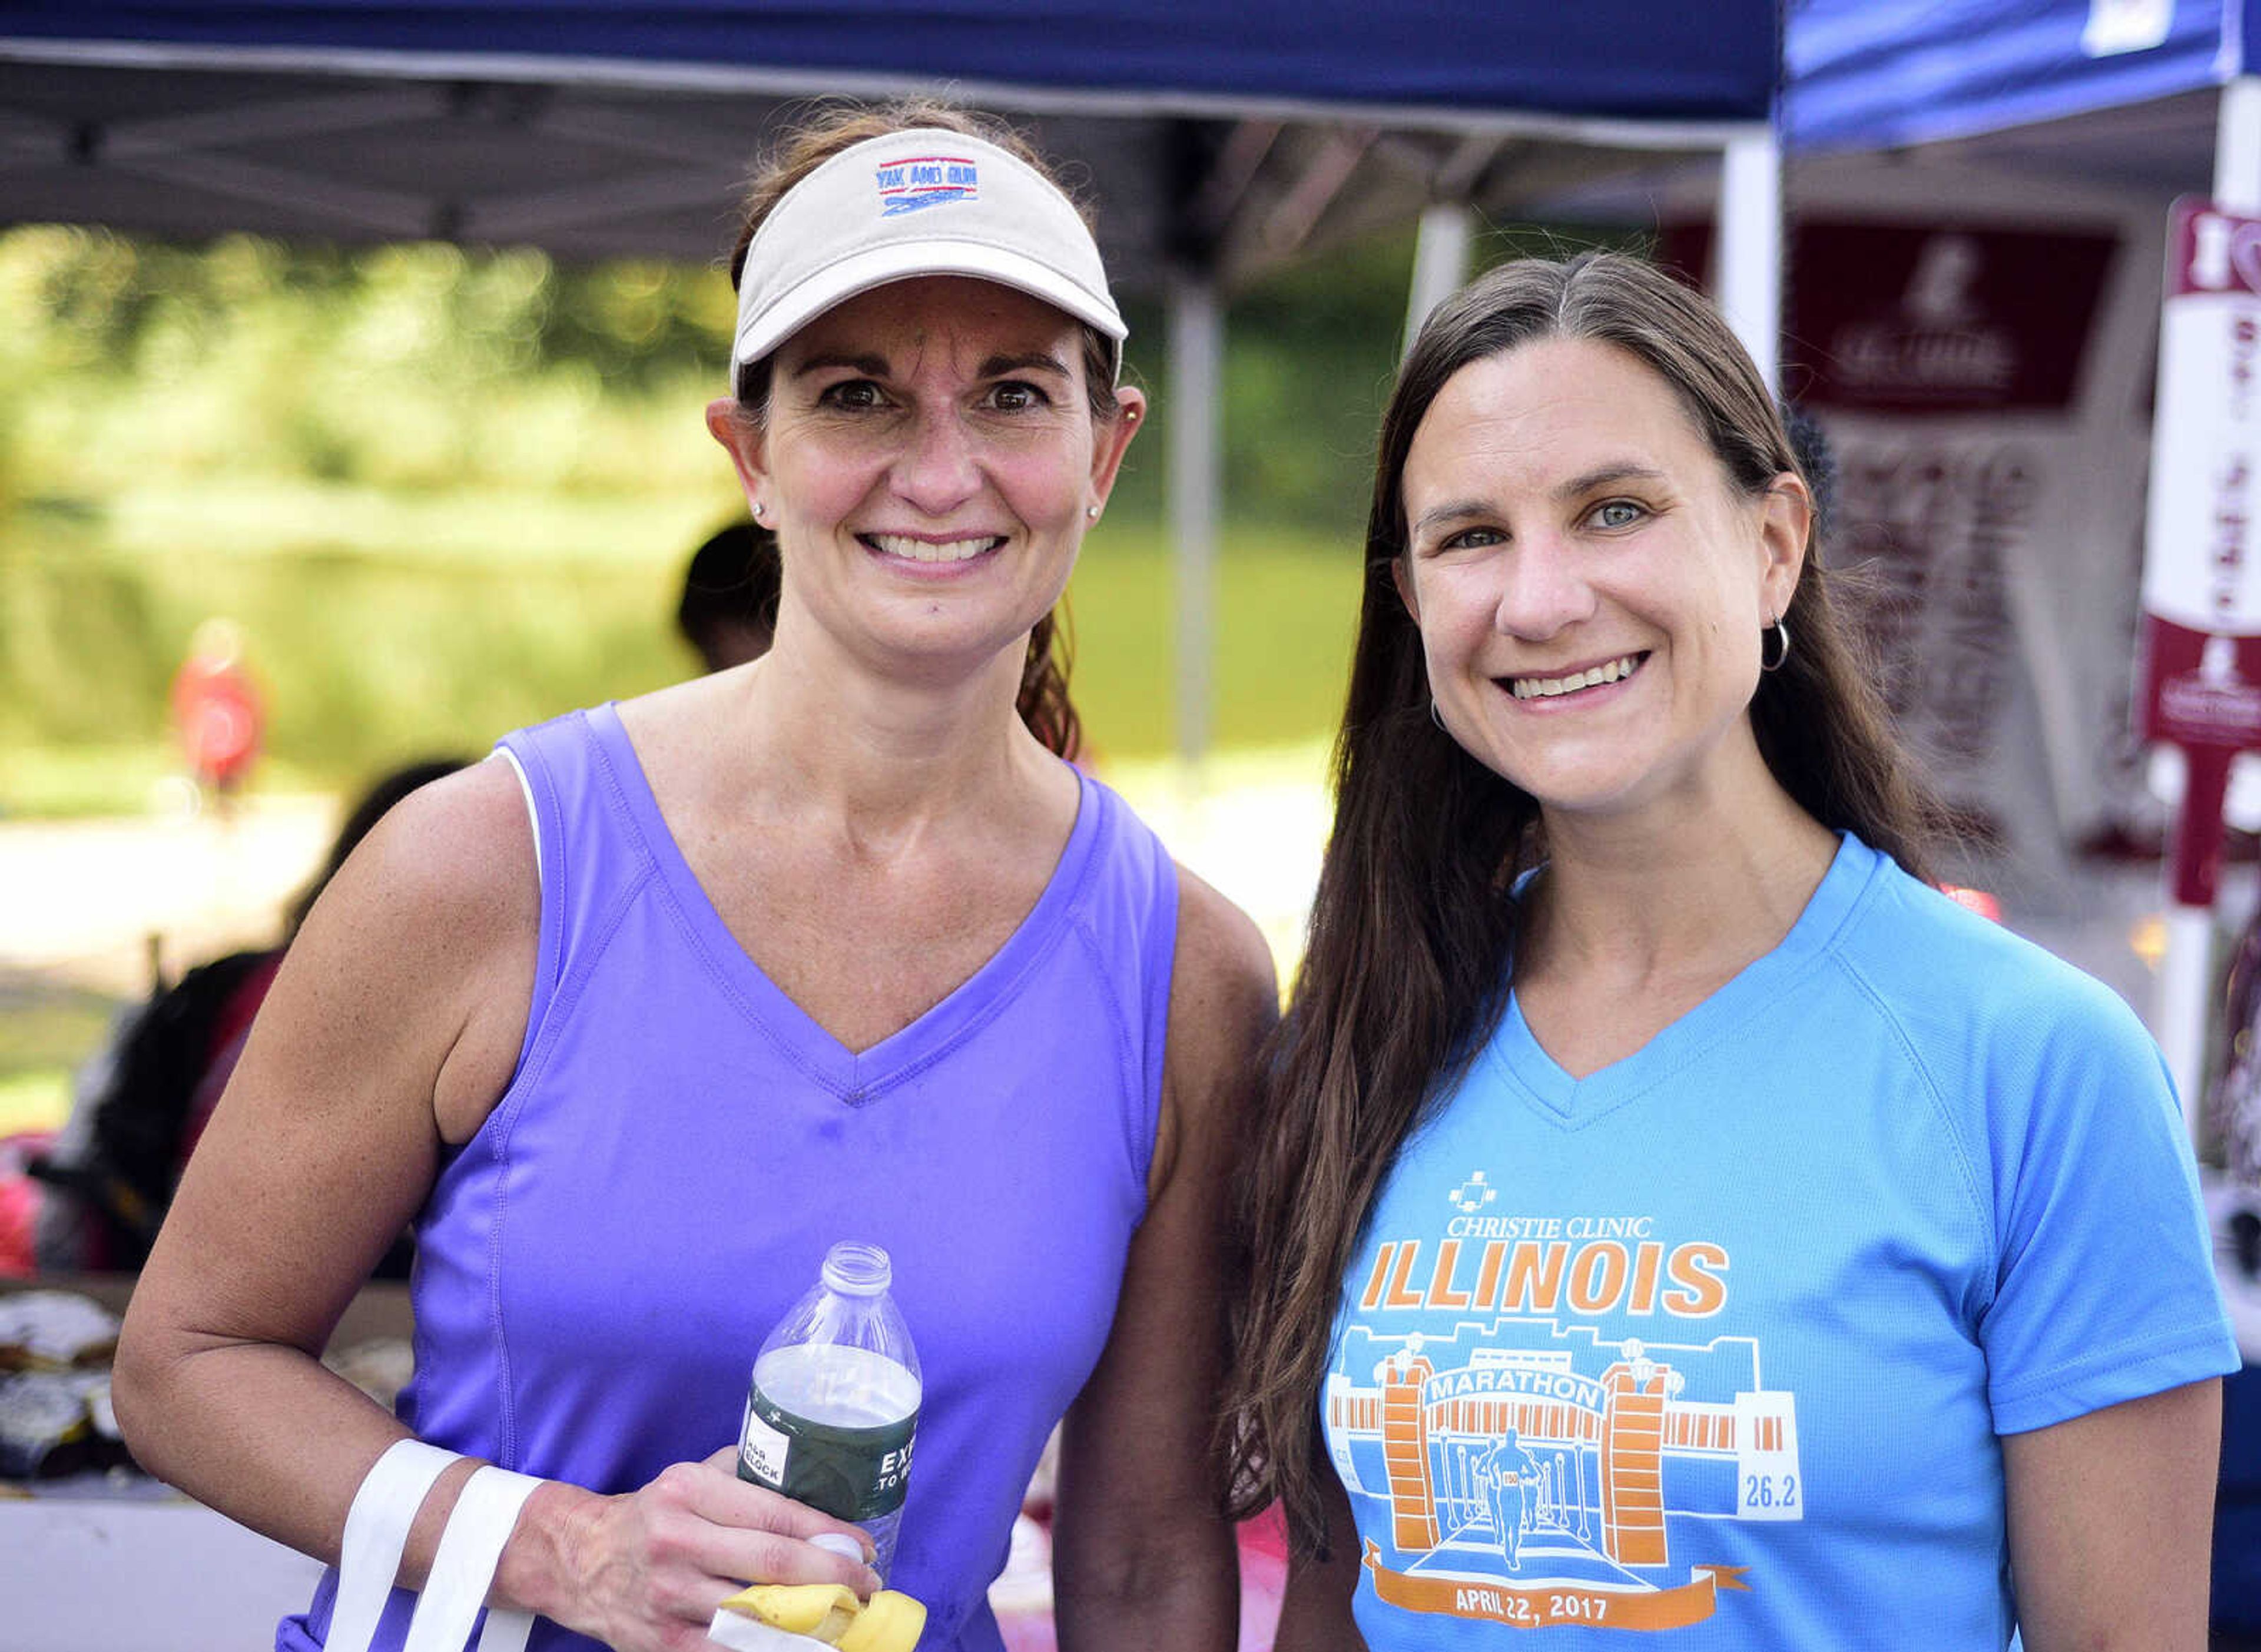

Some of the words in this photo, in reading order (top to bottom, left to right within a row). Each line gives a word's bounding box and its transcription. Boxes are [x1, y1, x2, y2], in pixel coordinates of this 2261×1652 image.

[877, 167, 905, 188] YAK
[911, 165, 941, 184] AND
[1447, 1216, 1560, 1239] CHRISTIE
[1566, 1216, 1653, 1239] CLINIC
[1358, 1239, 1730, 1319] ILLINOIS
[1431, 1369, 1599, 1408] MARATHON
[745, 1449, 778, 1480] BLOCK
[878, 1474, 897, 1491] TO
[1746, 1475, 1795, 1507] 26.2
[1456, 1588, 1504, 1616] APRIL
[1506, 1596, 1541, 1627] 22,
[1550, 1595, 1607, 1620] 2017
